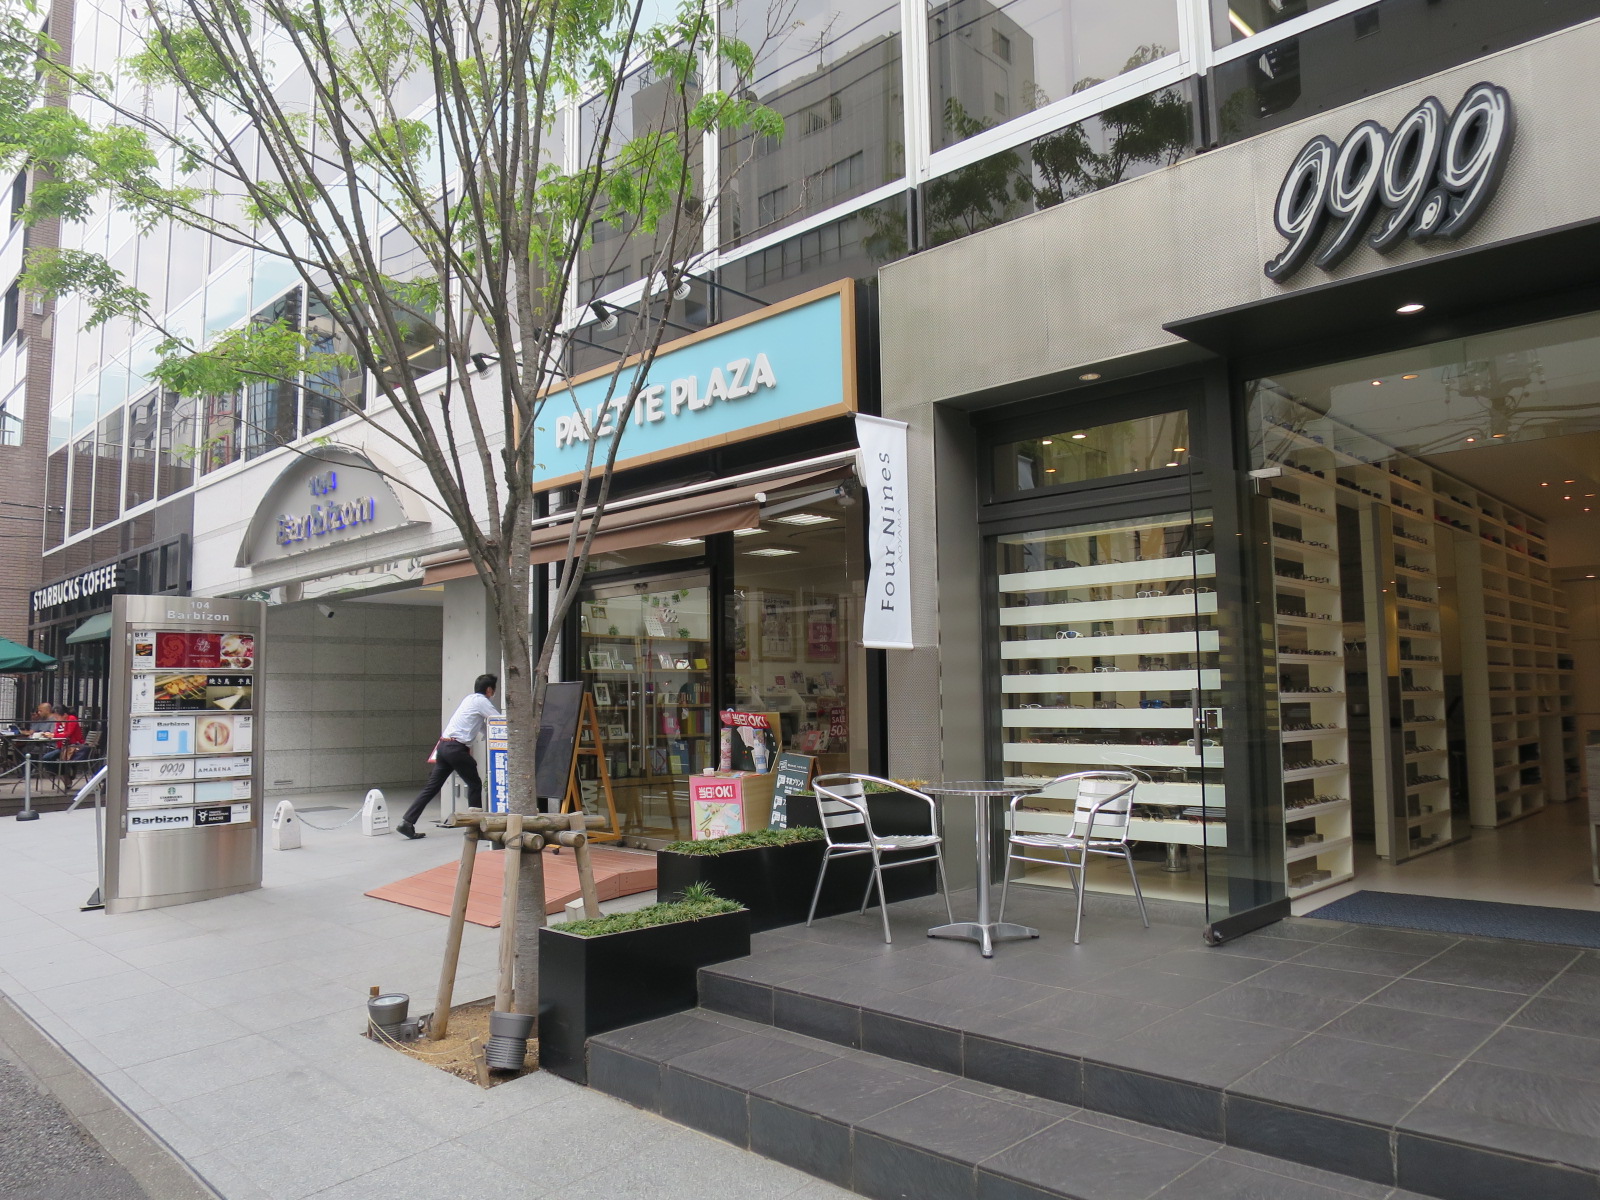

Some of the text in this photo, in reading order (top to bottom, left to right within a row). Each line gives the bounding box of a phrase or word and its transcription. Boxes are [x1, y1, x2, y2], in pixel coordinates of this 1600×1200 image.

[1264, 81, 1516, 283] 999.9
[555, 353, 777, 449] PALETTE PLAZA
[275, 496, 375, 545] Barbizon
[879, 452, 896, 611] Four Nines
[33, 564, 117, 611] STARBUCKS COFFEE
[190, 601, 211, 610] 104
[167, 610, 230, 622] Barbizon
[131, 815, 189, 825] Barbizon
